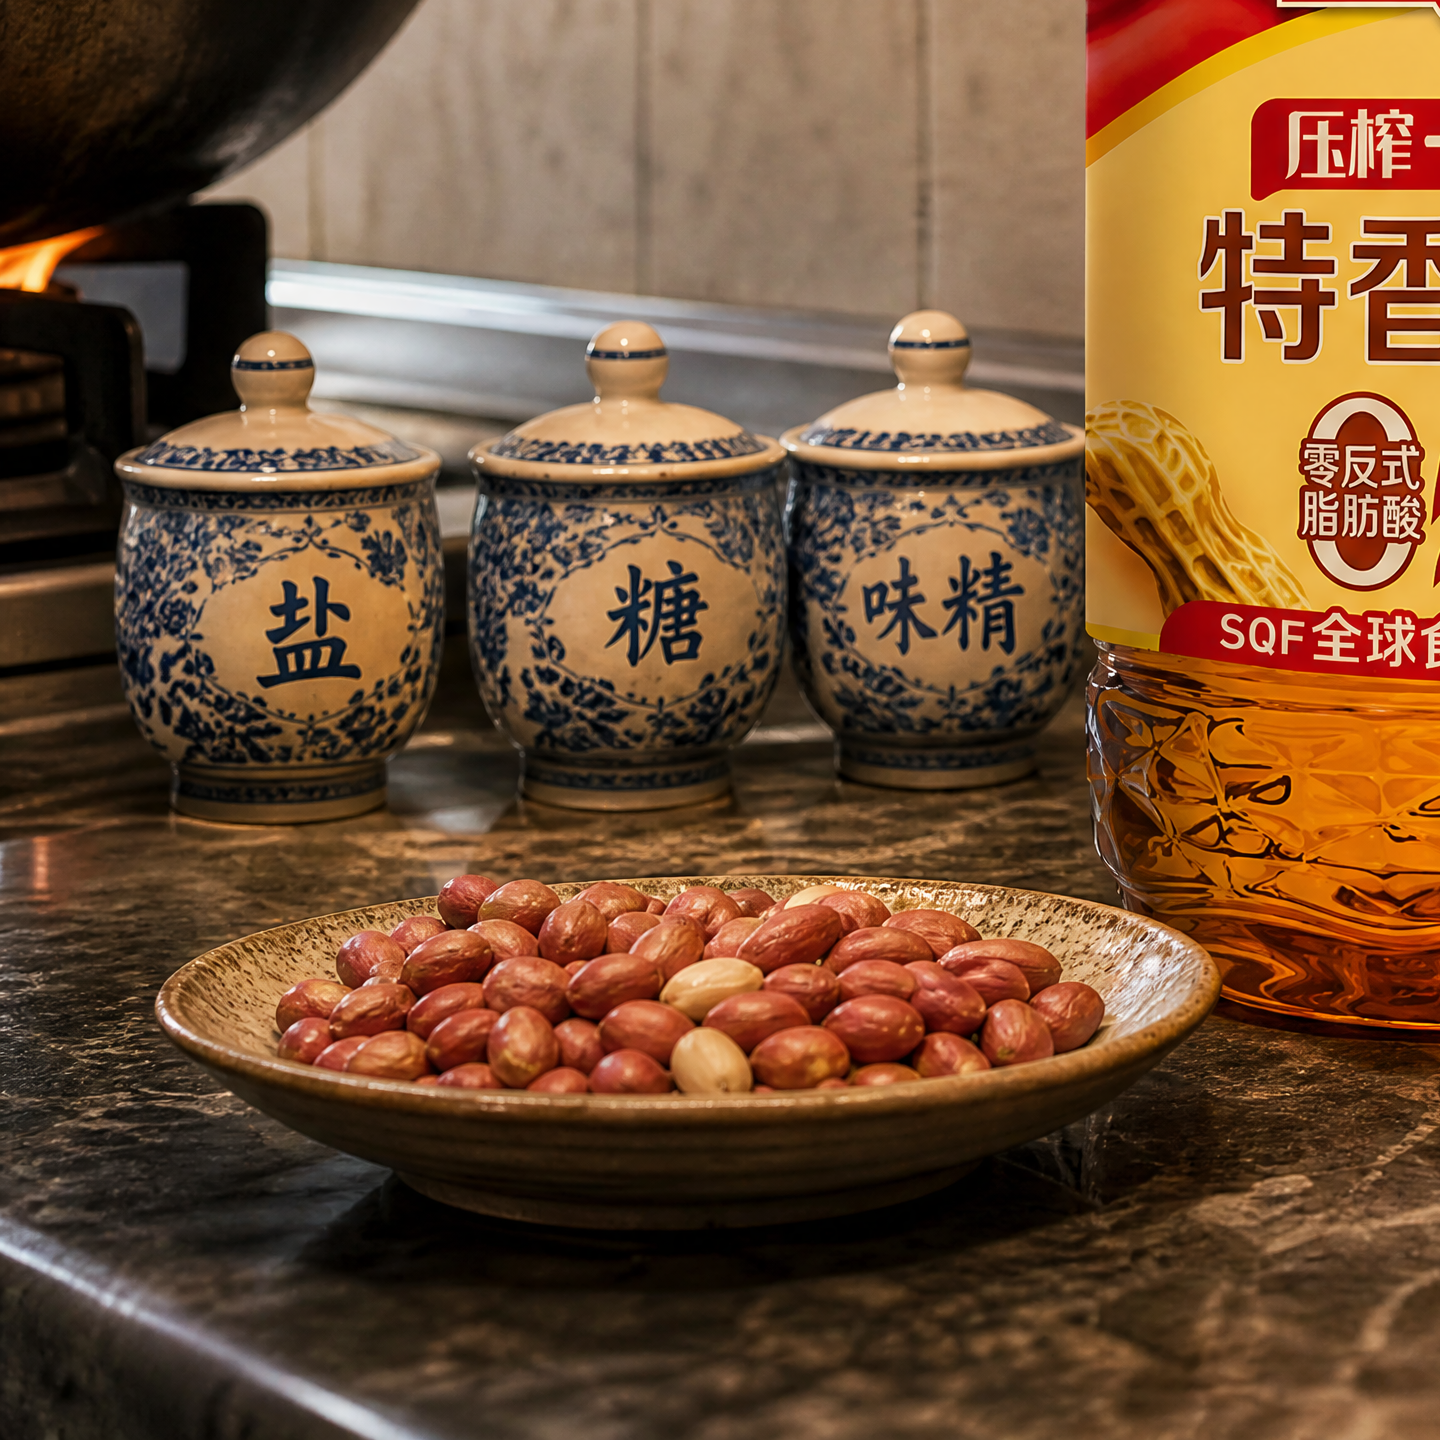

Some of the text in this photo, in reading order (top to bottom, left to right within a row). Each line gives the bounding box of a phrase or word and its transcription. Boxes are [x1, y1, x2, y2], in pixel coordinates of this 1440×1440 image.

[1301, 491, 1422, 538] 脂肪酸
[1303, 444, 1420, 490] 零反式
[256, 576, 361, 688] 盐
[604, 558, 709, 667] 糖
[861, 551, 1026, 656] 味精
